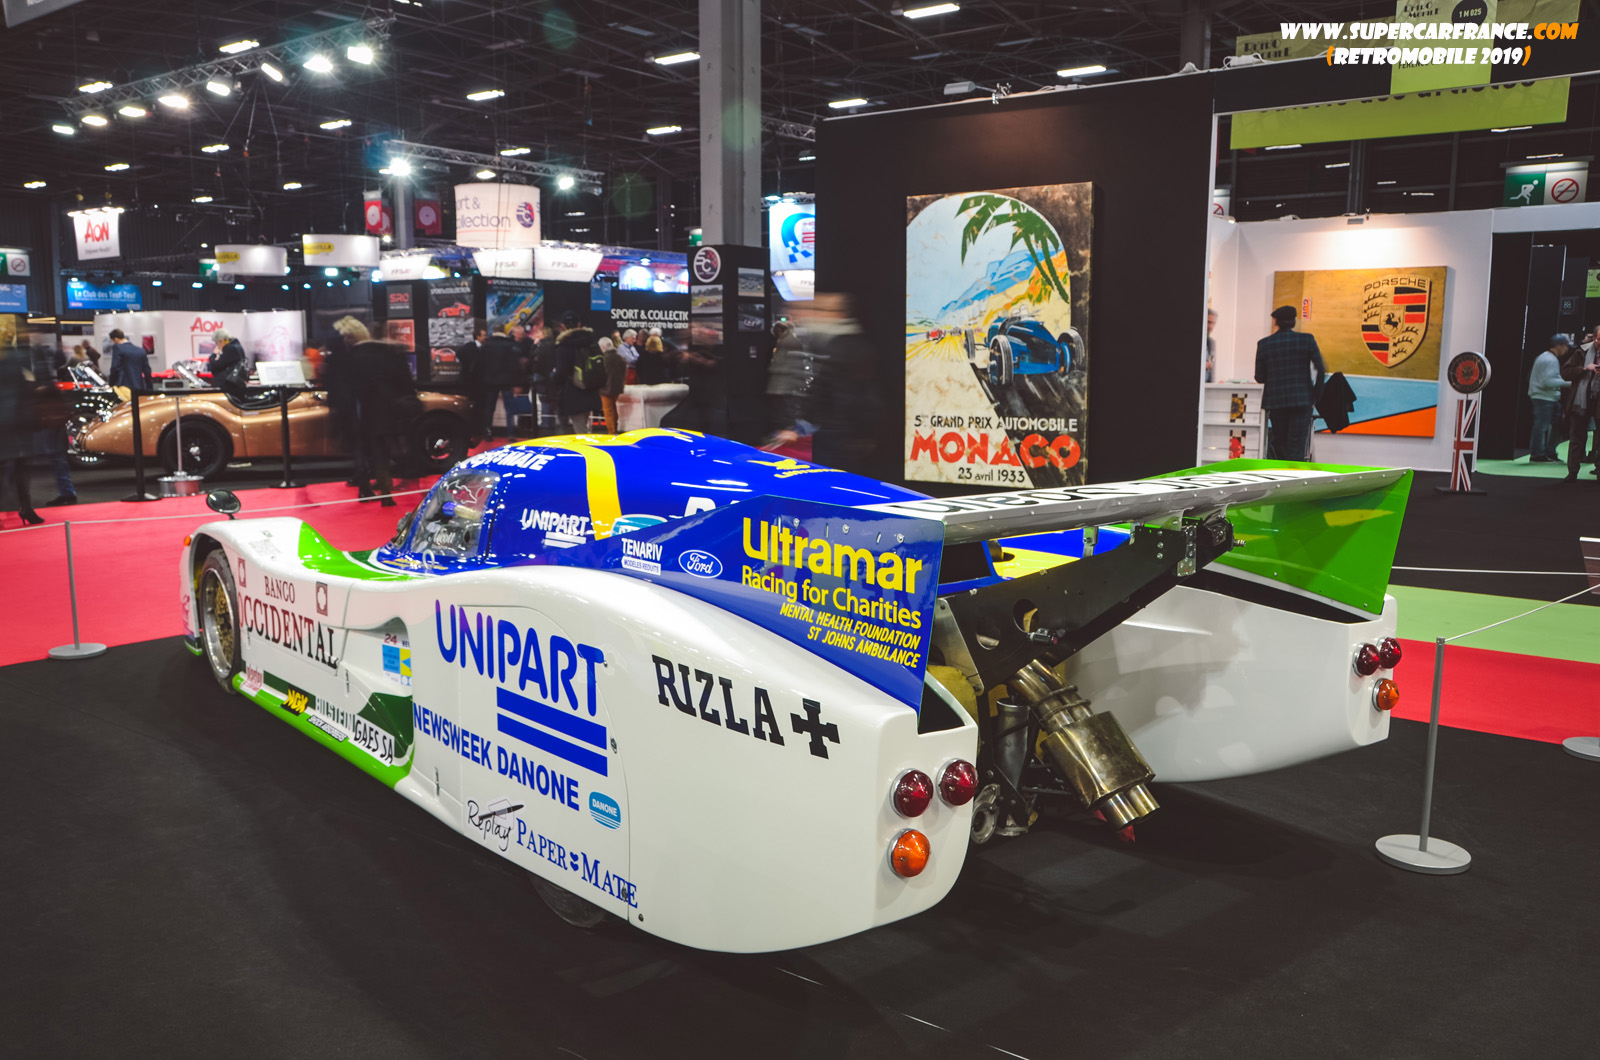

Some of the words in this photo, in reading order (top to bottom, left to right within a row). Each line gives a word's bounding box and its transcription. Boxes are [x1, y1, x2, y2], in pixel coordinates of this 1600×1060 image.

[1470, 8, 1482, 17] 025
[472, 197, 481, 209] &
[1364, 277, 1427, 292] PORSCHE
[611, 308, 639, 320] SPORT
[640, 310, 647, 319] &
[930, 415, 964, 428] GRAND
[996, 416, 1078, 432] AUTOMOBILE
[909, 429, 1081, 469] MONACO
[958, 467, 972, 480] 23
[974, 468, 993, 481] avril
[997, 468, 1025, 483] 1933
[520, 508, 590, 537] UNIPART
[621, 537, 663, 562] TENARIV
[624, 559, 642, 569] MODELES
[687, 552, 714, 574] Ford
[742, 516, 923, 594] Ultramar
[264, 575, 296, 604] BANCO
[742, 565, 798, 602] Racing
[801, 578, 829, 606] for
[832, 587, 922, 629] Charities
[238, 592, 338, 670] OCCIDENTAL
[384, 632, 398, 645] 24
[780, 601, 814, 623] MENTAL
[816, 610, 853, 634] HEALTH
[853, 620, 921, 650] FOUNDATION
[435, 599, 604, 717] UNIPART
[807, 626, 822, 641] ST
[821, 629, 855, 651] JOHNS
[855, 638, 921, 668] AMBULANCE
[283, 688, 309, 714] NGK
[652, 654, 785, 747] RIZLA
[354, 719, 379, 752] GAES
[380, 735, 393, 764] SA
[413, 702, 493, 771] NEWSWEEK
[497, 745, 580, 812] DANONE
[592, 797, 618, 817] DANONE
[467, 799, 513, 852] Replay
[516, 817, 568, 872] PAPER
[580, 851, 638, 909] MATE
